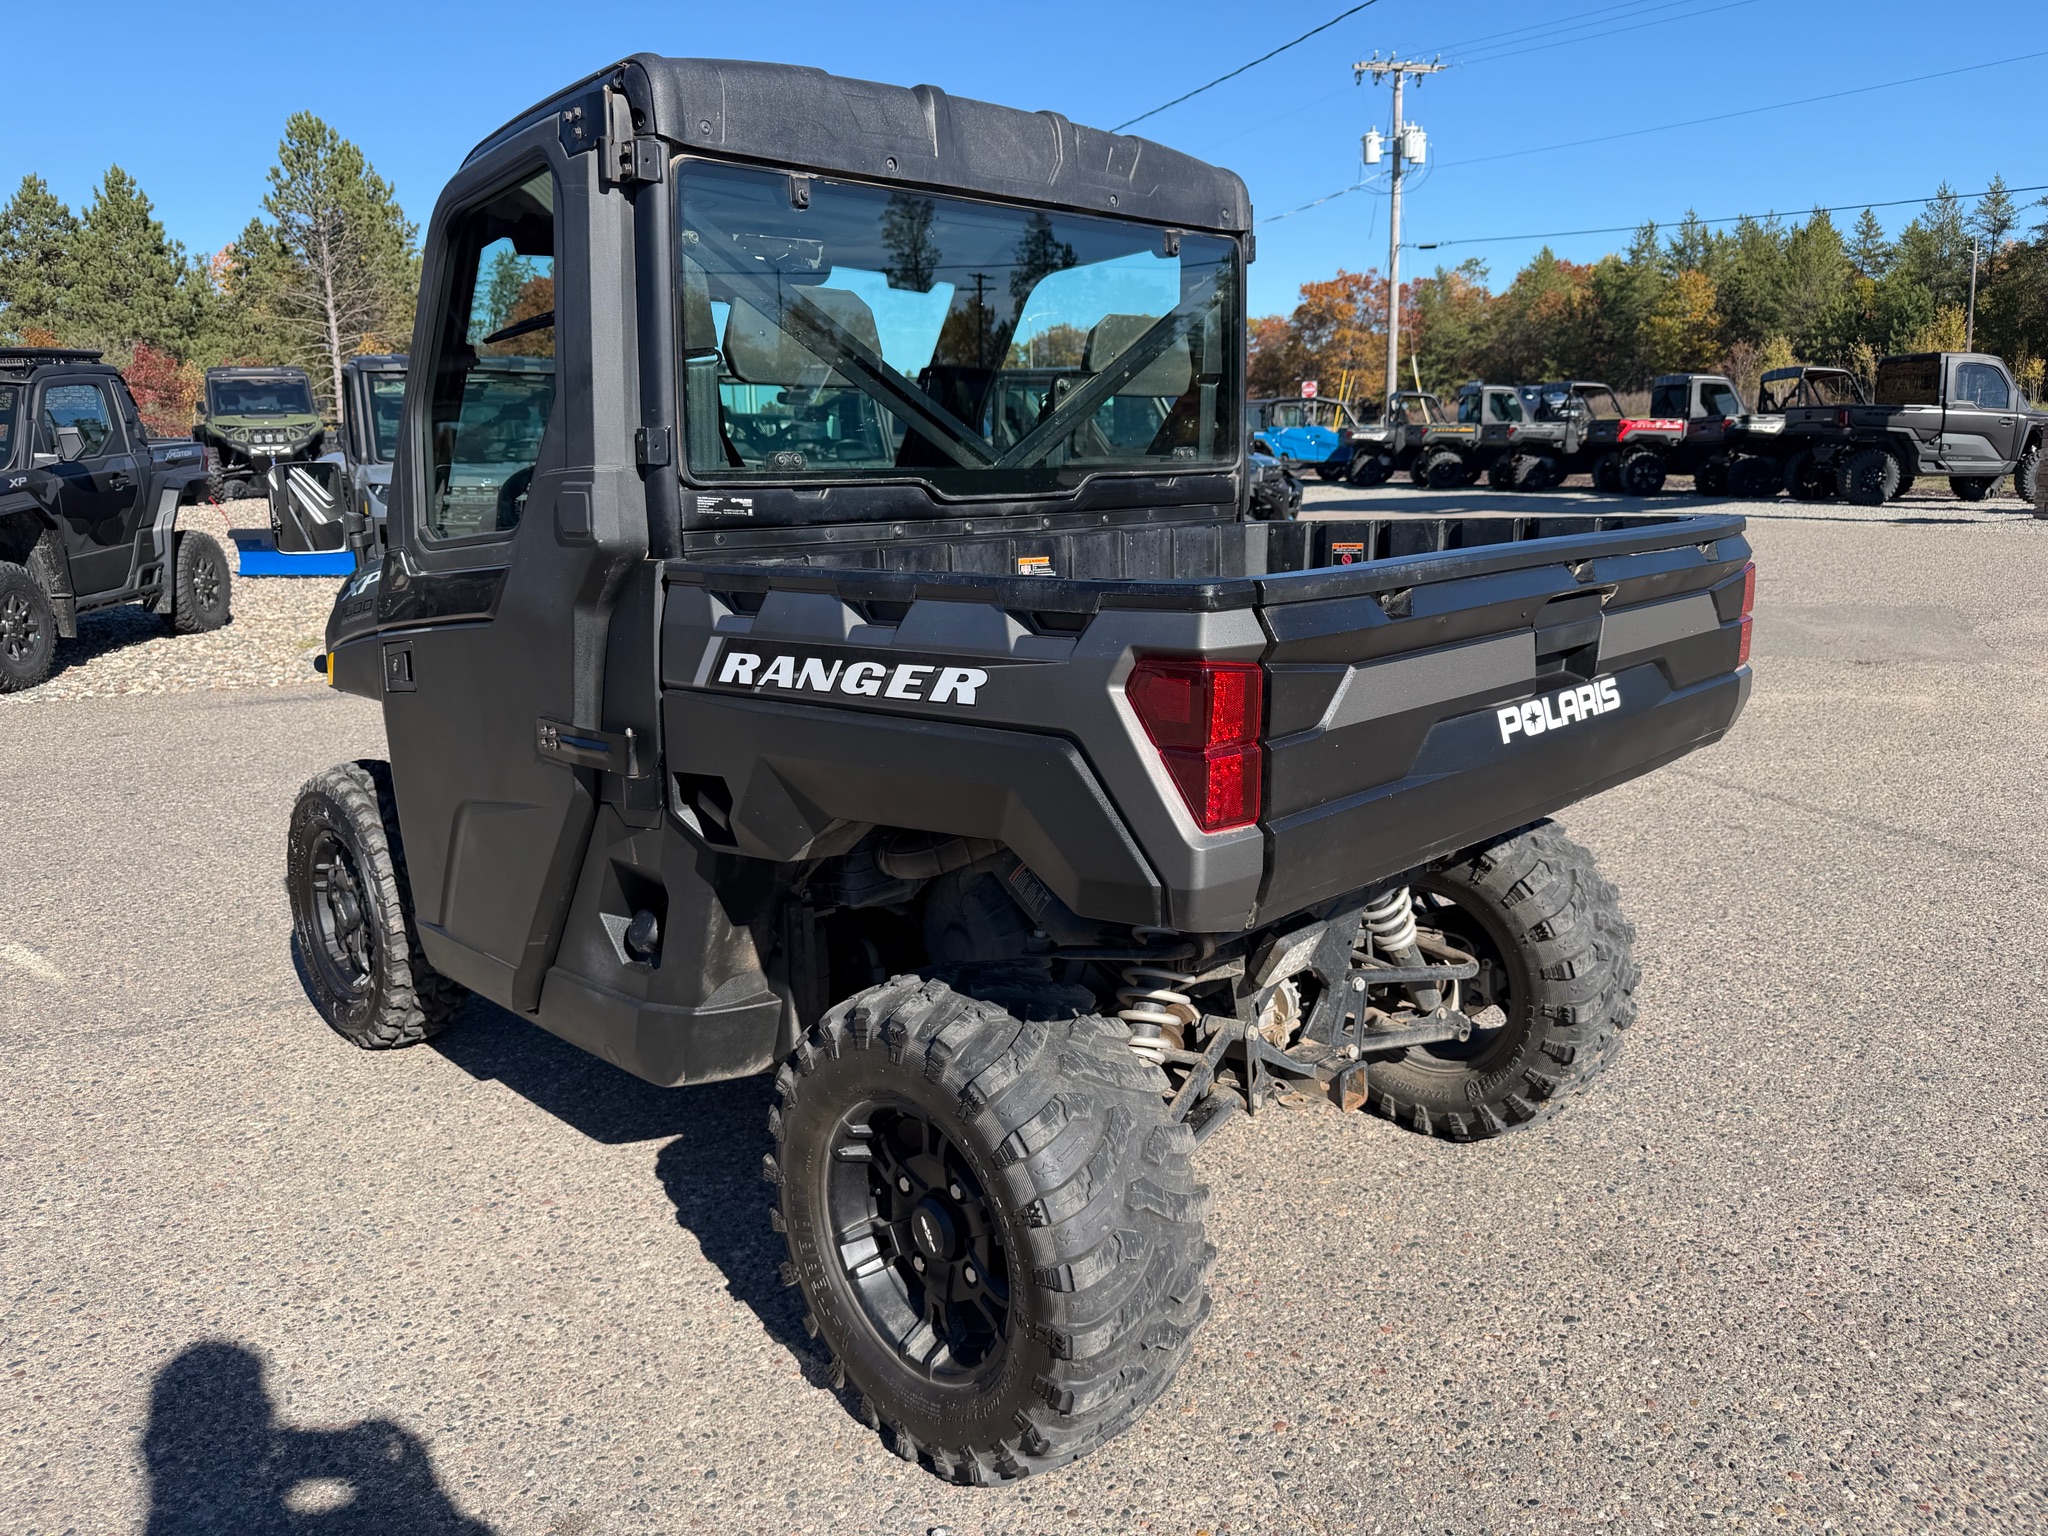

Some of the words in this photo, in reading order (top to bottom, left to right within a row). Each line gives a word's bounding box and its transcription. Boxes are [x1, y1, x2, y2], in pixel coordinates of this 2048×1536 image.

[8, 476, 27, 489] XP
[341, 570, 381, 602] XP
[342, 599, 374, 617] 1000
[718, 651, 989, 706] RANGER
[1496, 676, 1621, 745] POLARIS
